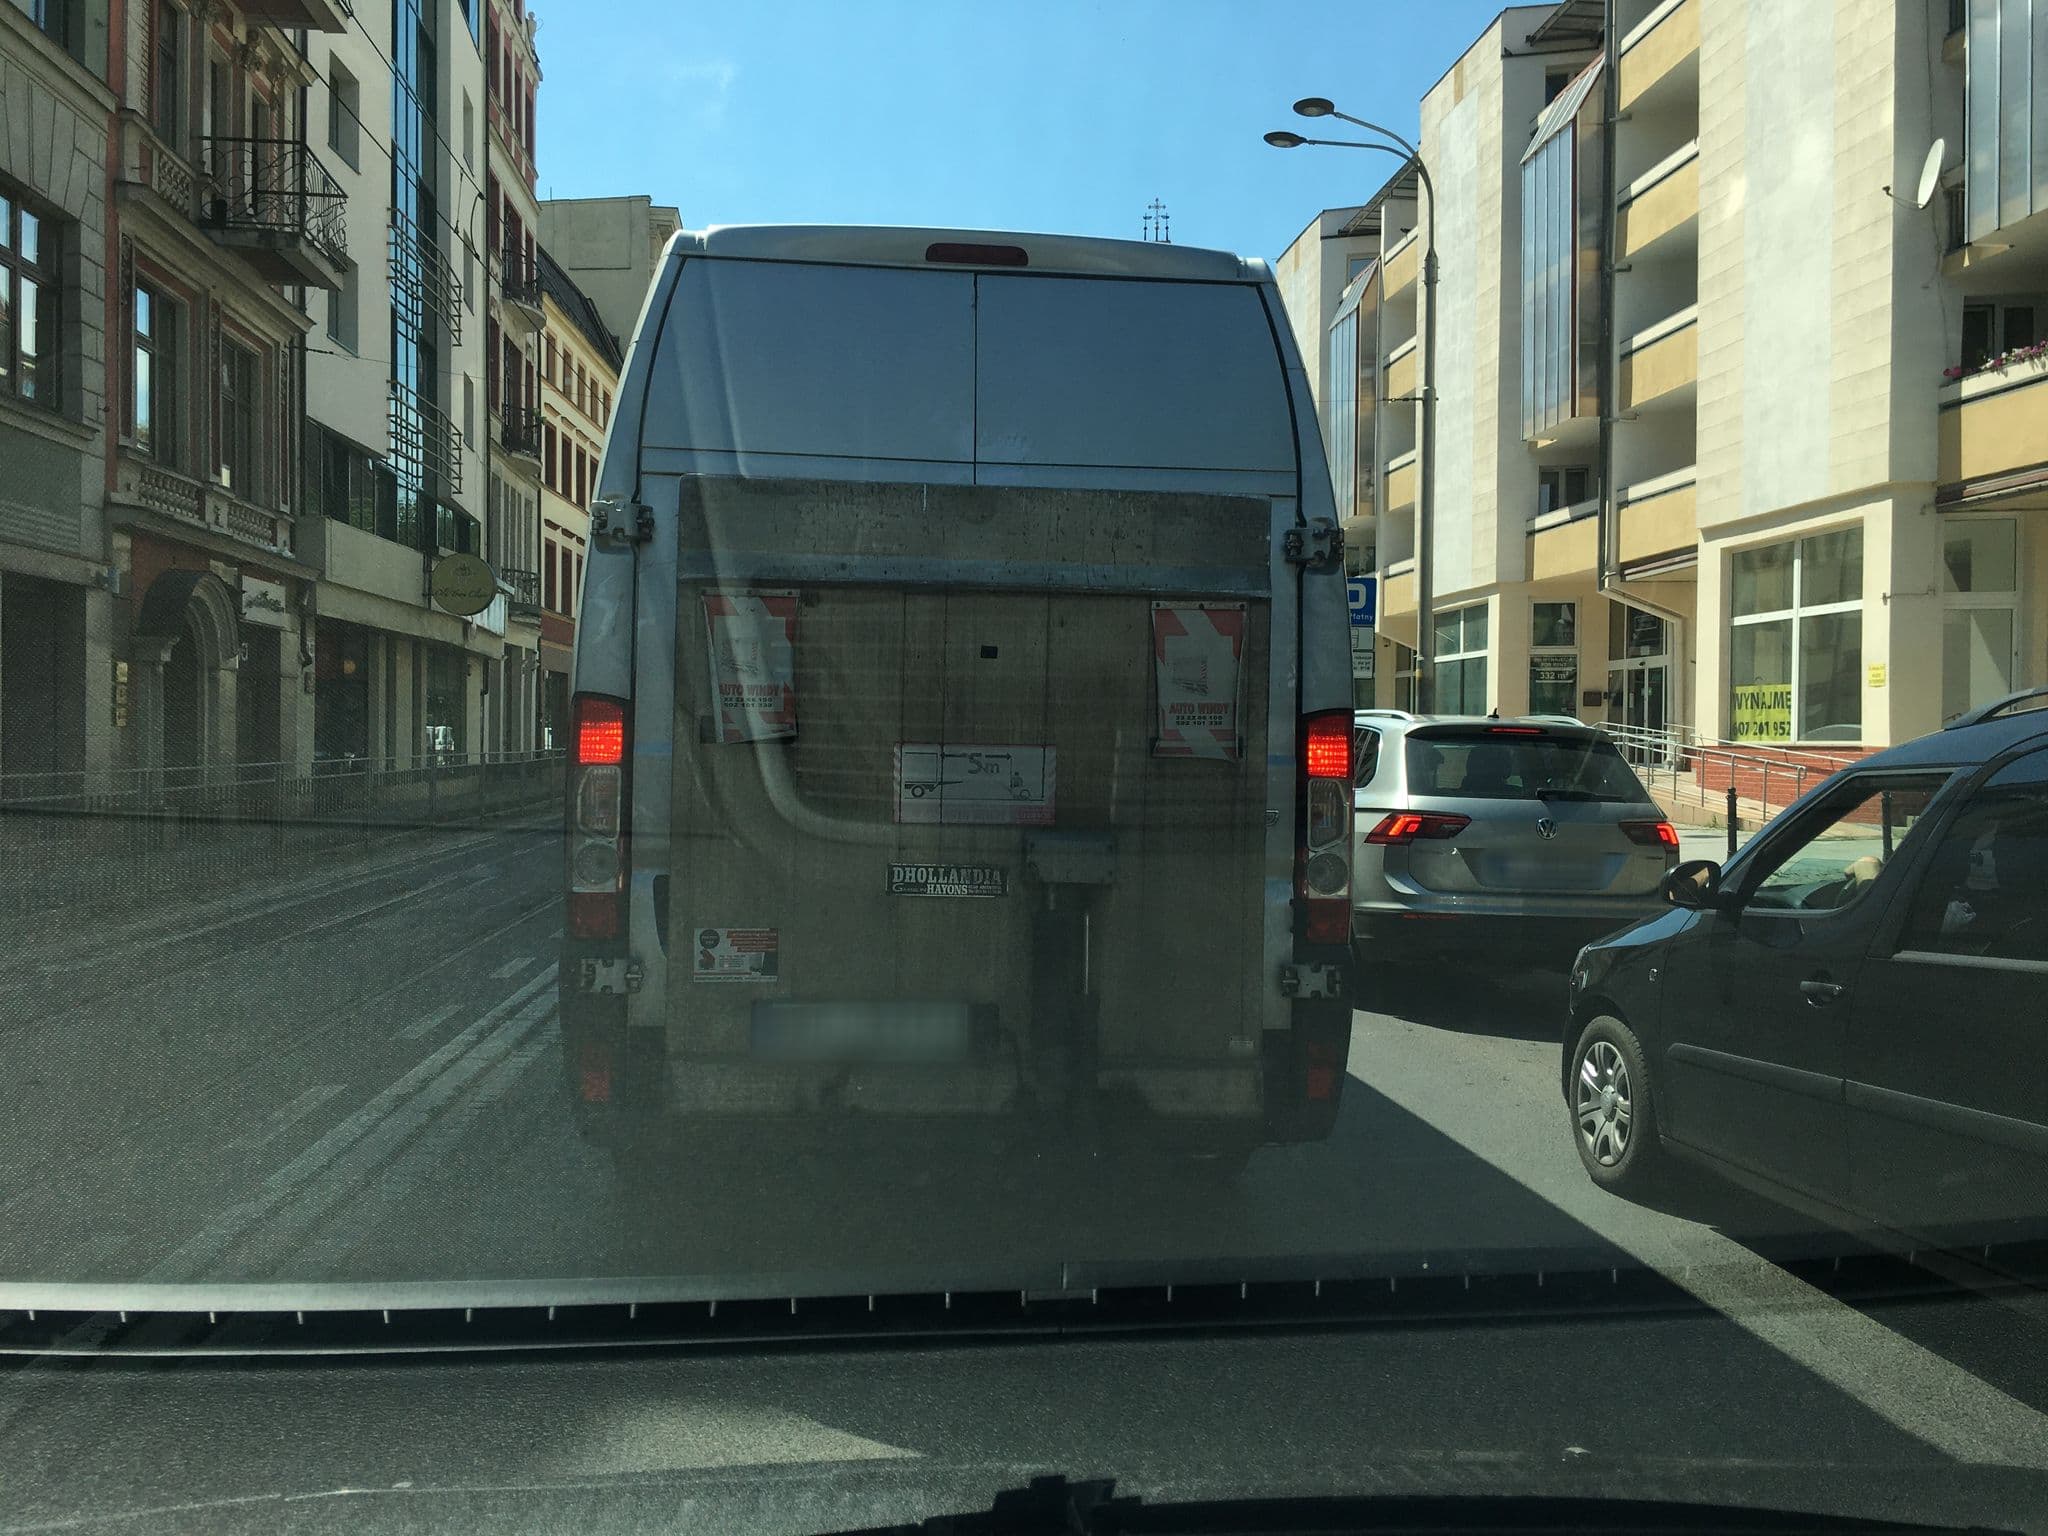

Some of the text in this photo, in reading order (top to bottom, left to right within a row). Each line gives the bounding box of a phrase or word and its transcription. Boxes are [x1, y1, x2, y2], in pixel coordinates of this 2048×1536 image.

[1540, 671, 1555, 679] 332
[1169, 703, 1195, 714] AUTO
[892, 867, 1002, 885] DHOLLANDIA
[926, 884, 968, 895] HAYONS
